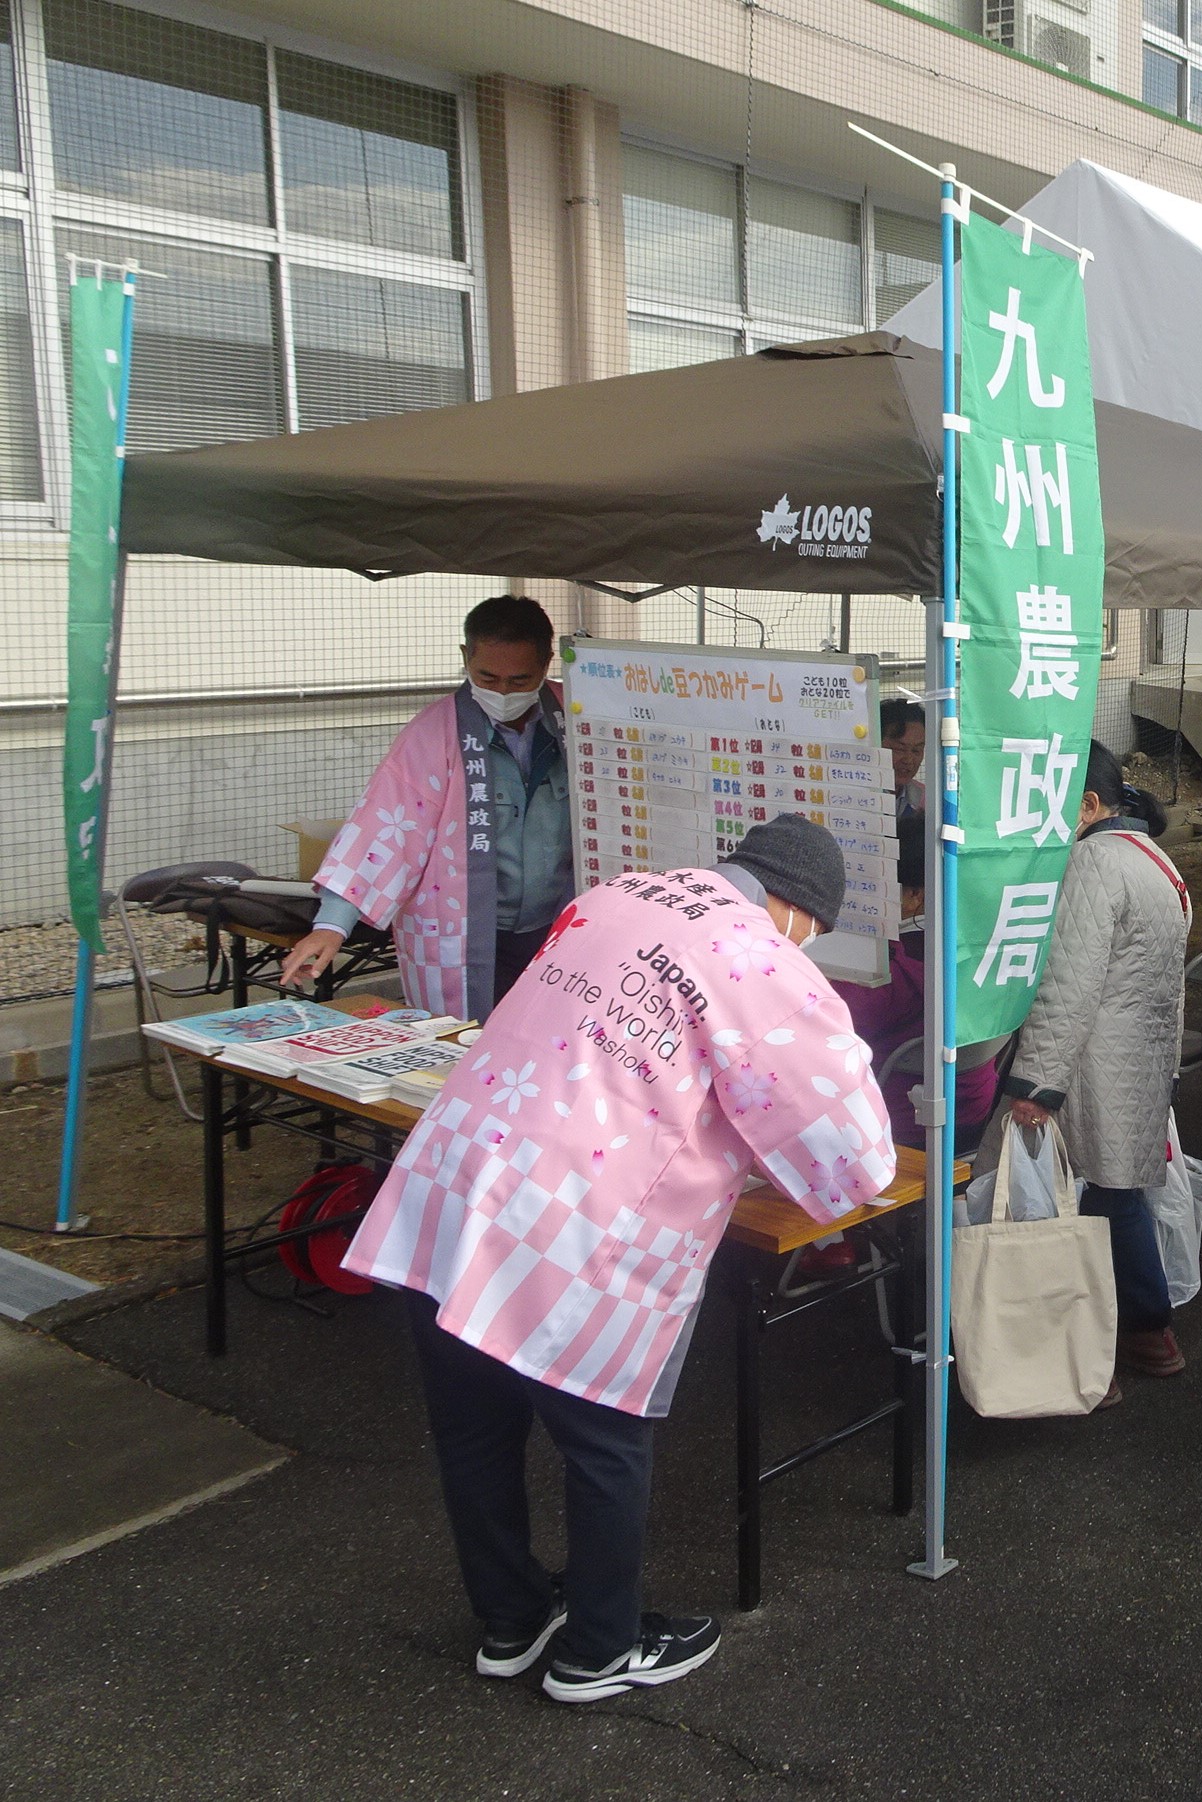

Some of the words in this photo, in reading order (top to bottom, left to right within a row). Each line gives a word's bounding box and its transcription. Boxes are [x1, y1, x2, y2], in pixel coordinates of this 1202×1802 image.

[775, 525, 794, 535] LOGOS
[801, 505, 872, 543] LOGOS
[798, 543, 824, 557] OUTING
[826, 544, 869, 559] EQUIPMENT
[972, 286, 1080, 988] 九州農政局
[710, 737, 739, 753] 第1位
[711, 757, 741, 775] 第2位
[463, 733, 491, 853] 九州農政局
[713, 778, 741, 795] 第3位
[714, 800, 743, 816] 第4位
[716, 818, 744, 836] 第5位
[716, 837, 740, 852] 第6
[539, 962, 563, 985] to
[563, 971, 602, 1004] the
[636, 943, 707, 1022] Japan.
[297, 1034, 360, 1051] SHIFT
[321, 1030, 375, 1045] FOOD
[344, 1024, 417, 1044] NIPPON
[576, 1014, 659, 1084] Washoku
[382, 1052, 436, 1068] FOOD
